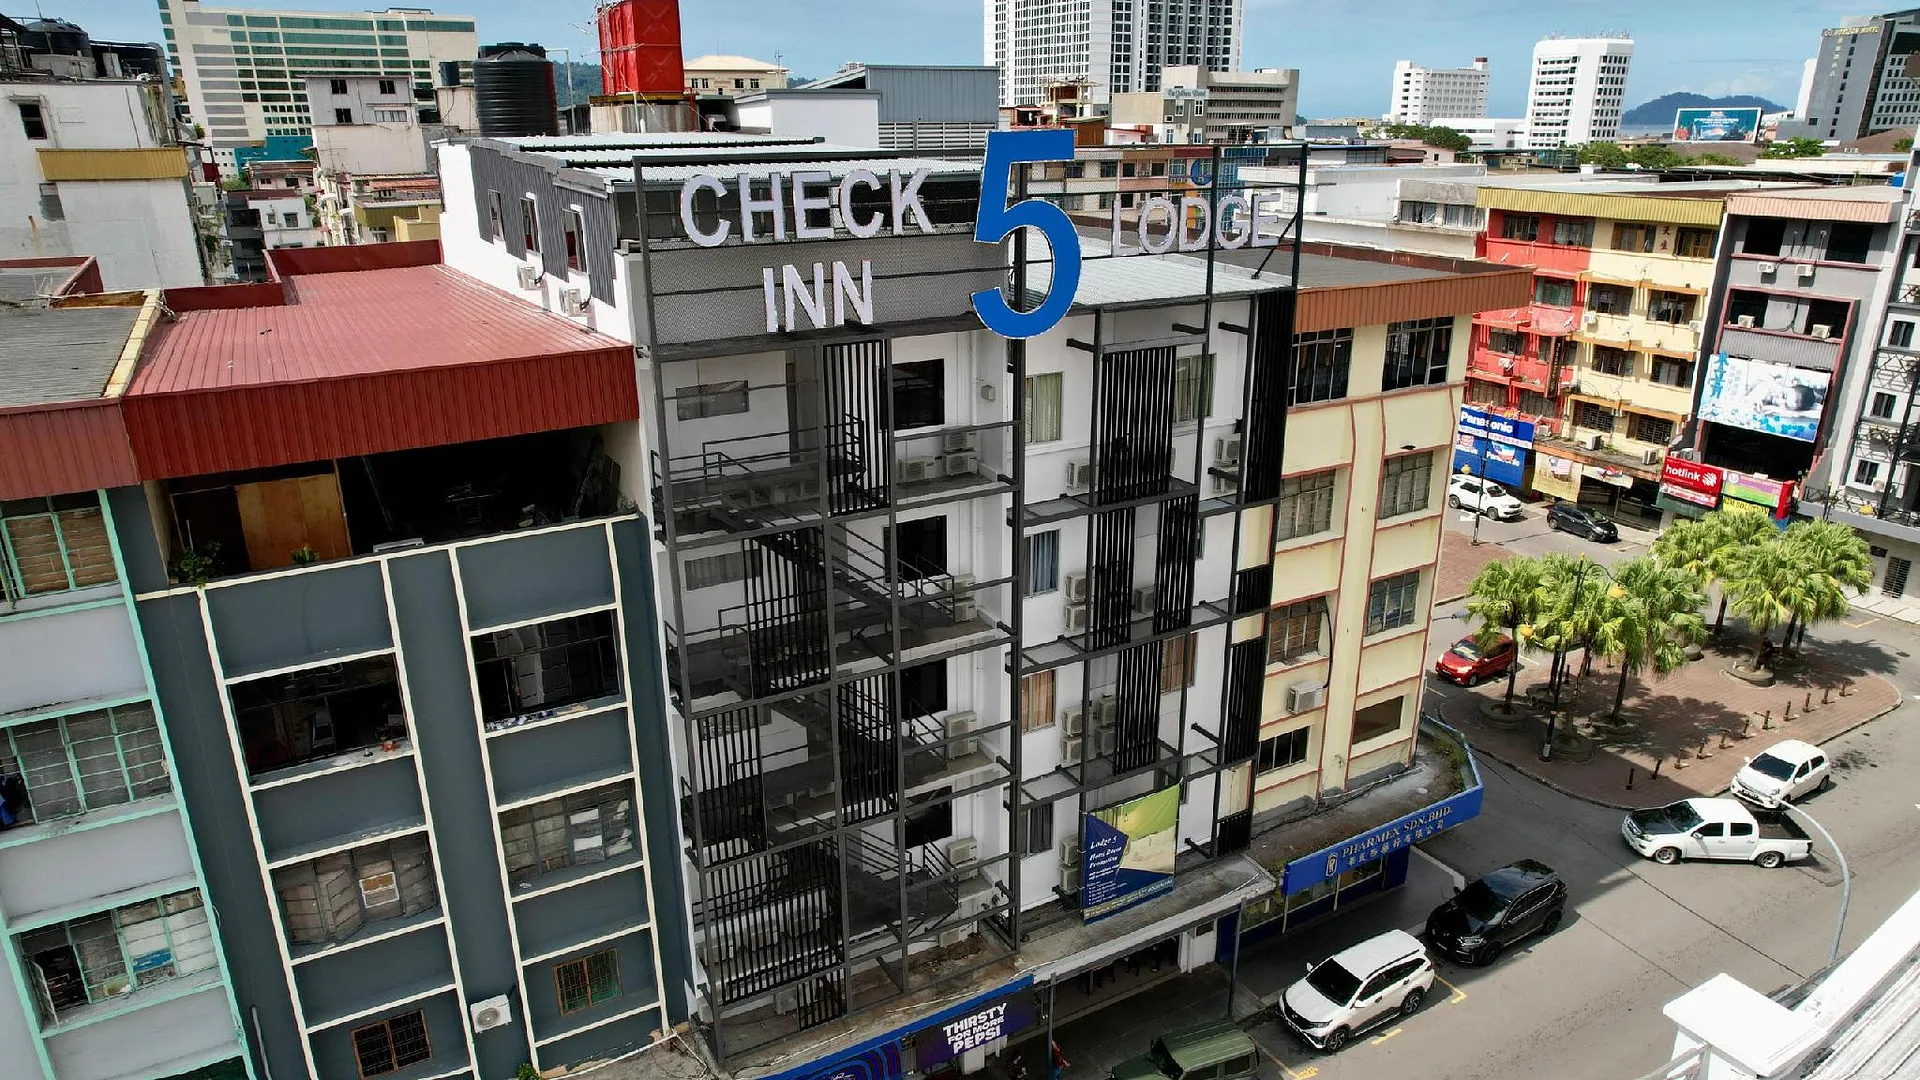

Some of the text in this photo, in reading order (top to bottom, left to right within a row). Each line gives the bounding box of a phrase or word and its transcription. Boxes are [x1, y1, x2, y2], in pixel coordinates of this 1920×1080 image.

[680, 168, 934, 247] CHECK
[1112, 192, 1281, 257] LODGE
[970, 129, 1081, 340] 5
[763, 259, 874, 332] INN
[1460, 410, 1513, 434] Panasonic
[1665, 463, 1701, 482] hotlink
[1090, 838, 1112, 850] Lodge
[1342, 826, 1400, 858] PHARMEX
[1428, 805, 1453, 822] BHD.
[942, 1002, 1007, 1037] THIRSTY
[947, 1015, 1005, 1046] FOR MORE
[953, 1025, 1001, 1055] PEPSI
